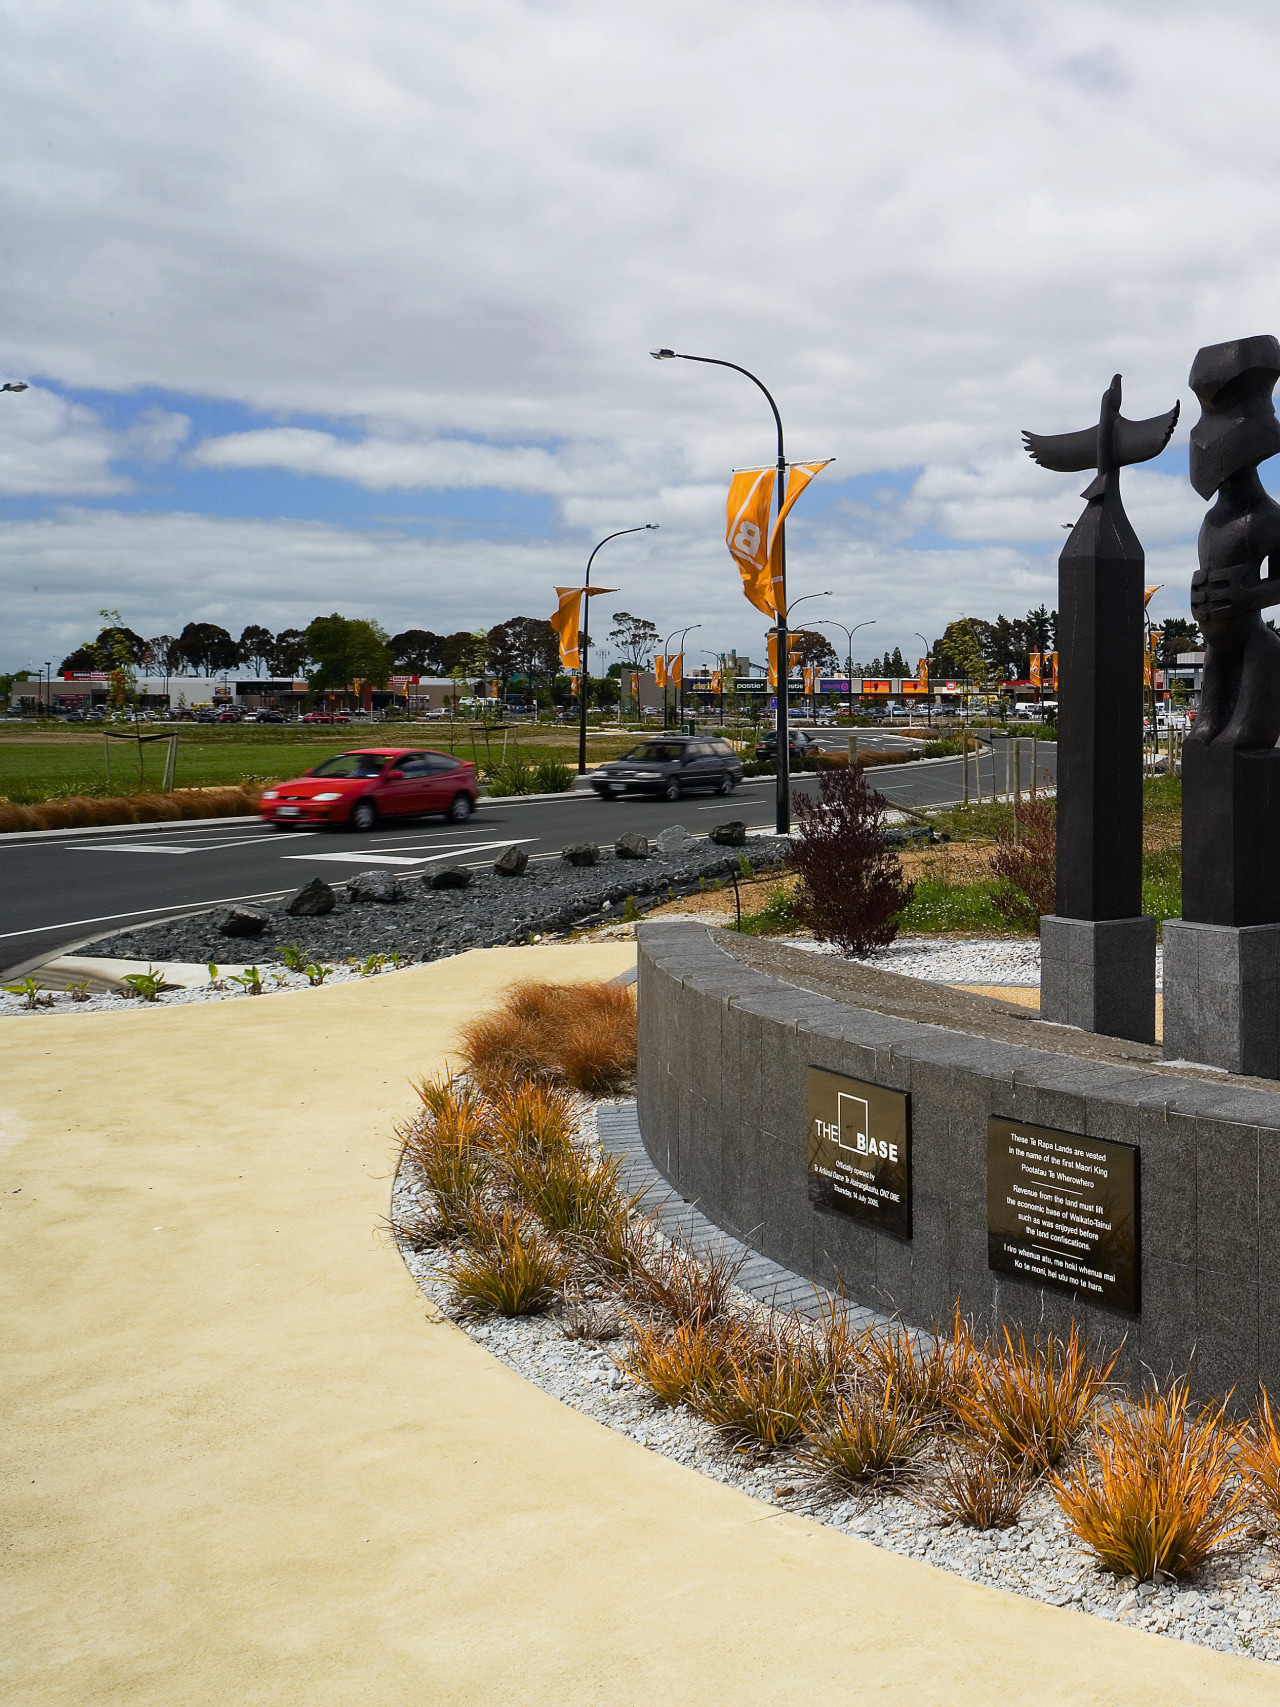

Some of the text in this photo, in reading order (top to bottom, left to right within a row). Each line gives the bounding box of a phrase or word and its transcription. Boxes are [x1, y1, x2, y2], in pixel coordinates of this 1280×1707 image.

[735, 521, 762, 558] B
[815, 1119, 838, 1143] THE
[856, 1132, 898, 1162] BASE
[1010, 1133, 1028, 1144] These
[1030, 1137, 1036, 1145] Te
[1038, 1139, 1053, 1150] Rapa
[1055, 1143, 1073, 1154] Lands
[1086, 1151, 1106, 1162] vested
[836, 1160, 875, 1181] Officially opened by
[1016, 1147, 1025, 1156] the
[1026, 1151, 1042, 1161] name
[1051, 1156, 1061, 1166] the
[1062, 1158, 1074, 1169] first
[1075, 1161, 1093, 1173] Maori
[1094, 1166, 1108, 1178] King
[1048, 1170, 1055, 1178] Te
[1056, 1172, 1095, 1188] Wherowhero
[858, 1194, 867, 1204] July
[1006, 1196, 1016, 1206] the
[1017, 1201, 1044, 1213] economic
[1046, 1207, 1060, 1217] base
[1070, 1213, 1112, 1231] Waikato-Tainui
[1013, 1184, 1104, 1215] Revenue from the land must lift
[1018, 1213, 1032, 1222] such
[1042, 1220, 1054, 1228] was
[1055, 1223, 1078, 1235] enjoyed
[1079, 1229, 1099, 1240] before
[1026, 1226, 1091, 1251] the land confiscations.
[1015, 1259, 1104, 1293] Ko te moni, hei utu mo te hara.
[1018, 1249, 1040, 1261] whenua
[1042, 1255, 1053, 1265] atu,
[1054, 1259, 1064, 1268] me
[1065, 1261, 1078, 1272] hoki
[1079, 1266, 1102, 1279] whenua
[1104, 1274, 1116, 1283] mai
